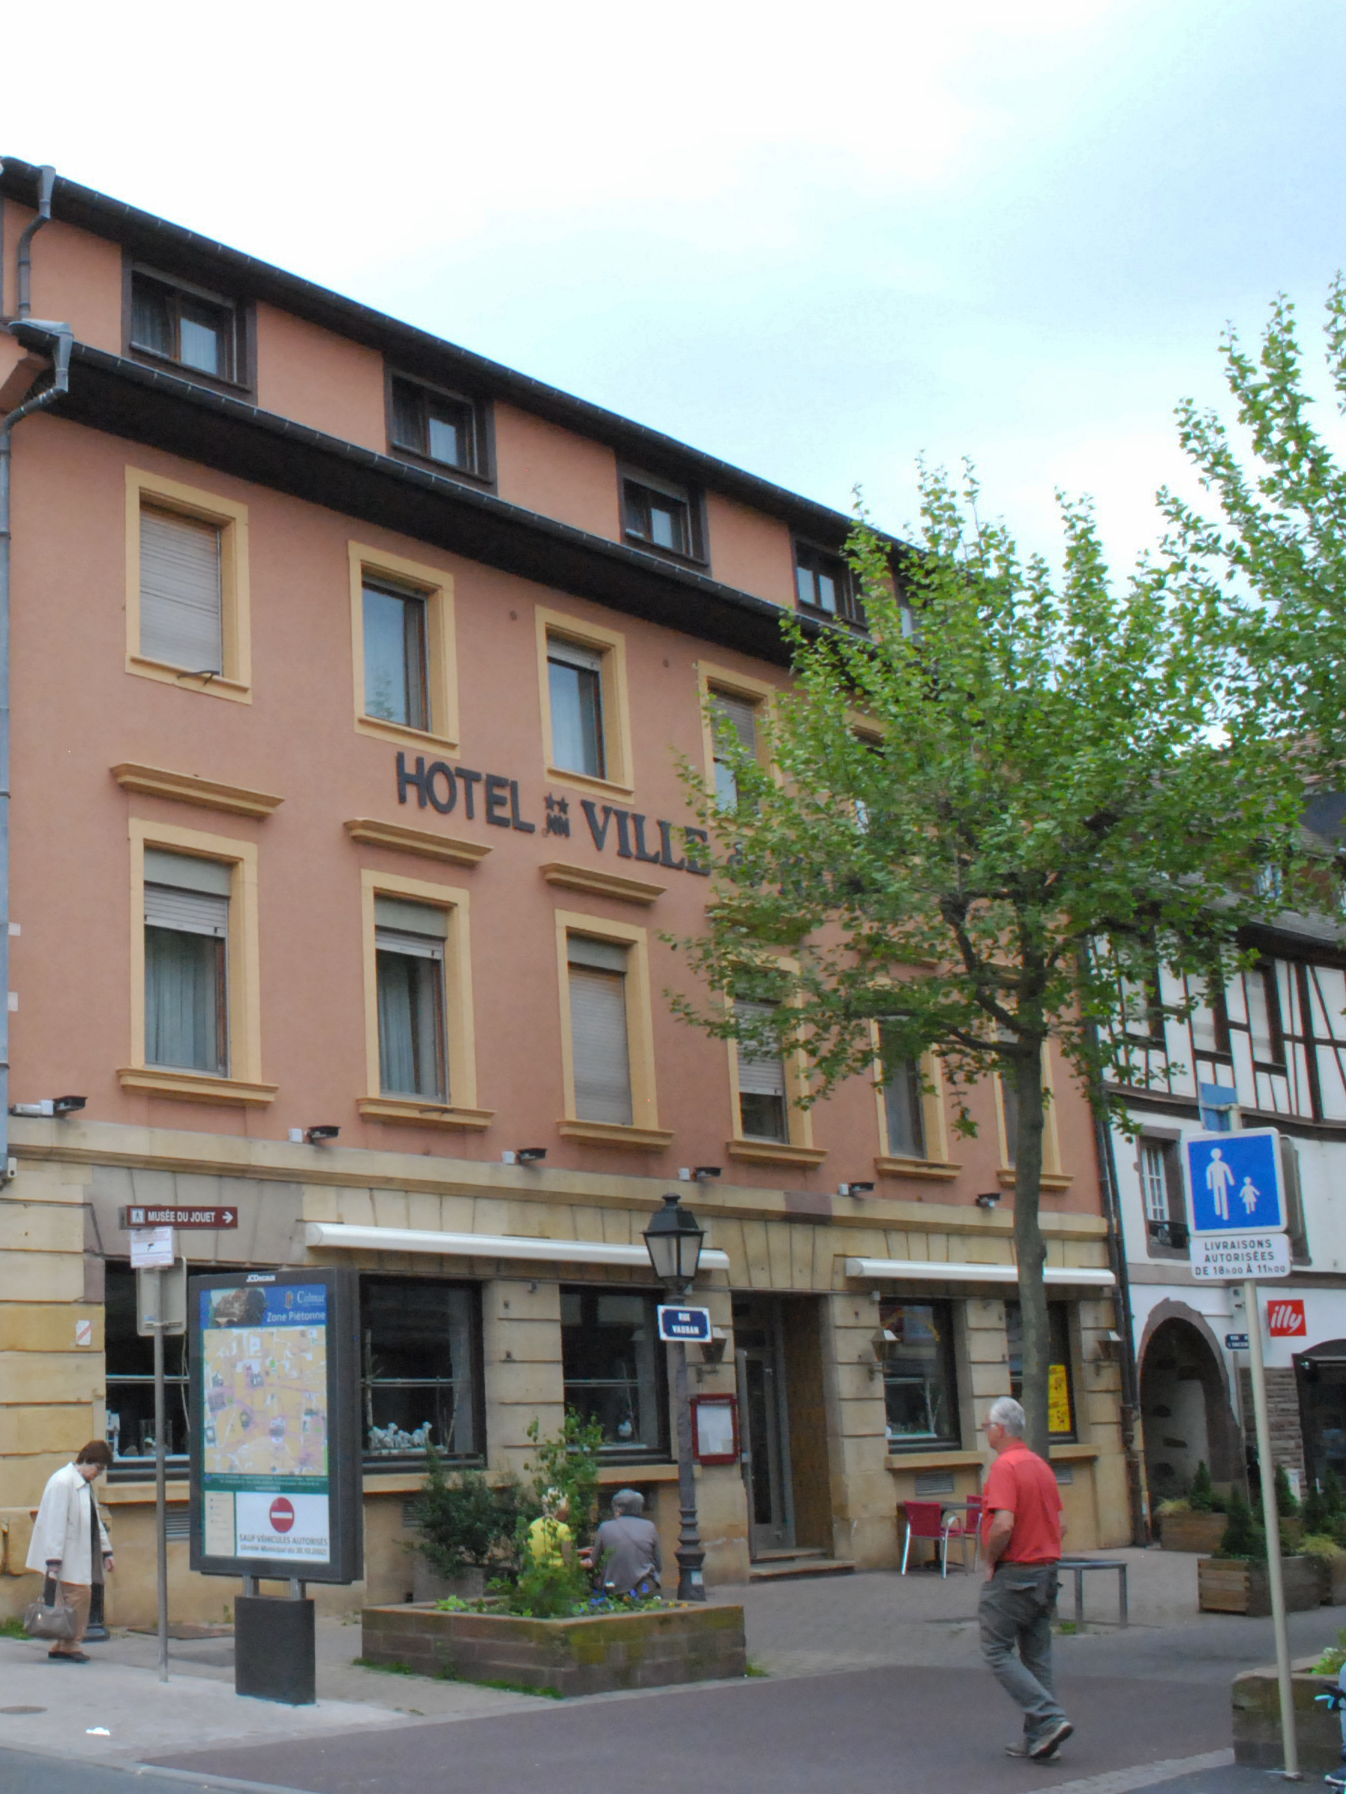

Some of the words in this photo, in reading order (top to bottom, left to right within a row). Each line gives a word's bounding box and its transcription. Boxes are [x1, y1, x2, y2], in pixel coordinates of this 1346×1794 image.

[396, 751, 535, 833] HOTEL
[580, 799, 712, 876] VILLE
[147, 1209, 175, 1222] MUSÉE
[177, 1211, 188, 1222] DU
[190, 1211, 215, 1222] JOUET
[1204, 1239, 1272, 1251] LIVRAISONS
[1204, 1250, 1275, 1263] AUTORISÉES
[1195, 1266, 1209, 1275] DE
[1246, 1263, 1253, 1273] À
[1257, 1264, 1286, 1273] 11h00
[297, 1290, 325, 1303] Colmar
[266, 1312, 286, 1322] Zone
[288, 1311, 326, 1321] Piétonne
[678, 1312, 691, 1322] RUE
[1270, 1305, 1302, 1334] illy
[239, 1534, 255, 1542] SAUF
[257, 1534, 290, 1544] VÉHICULES
[292, 1536, 328, 1546] AUTORISÉS
